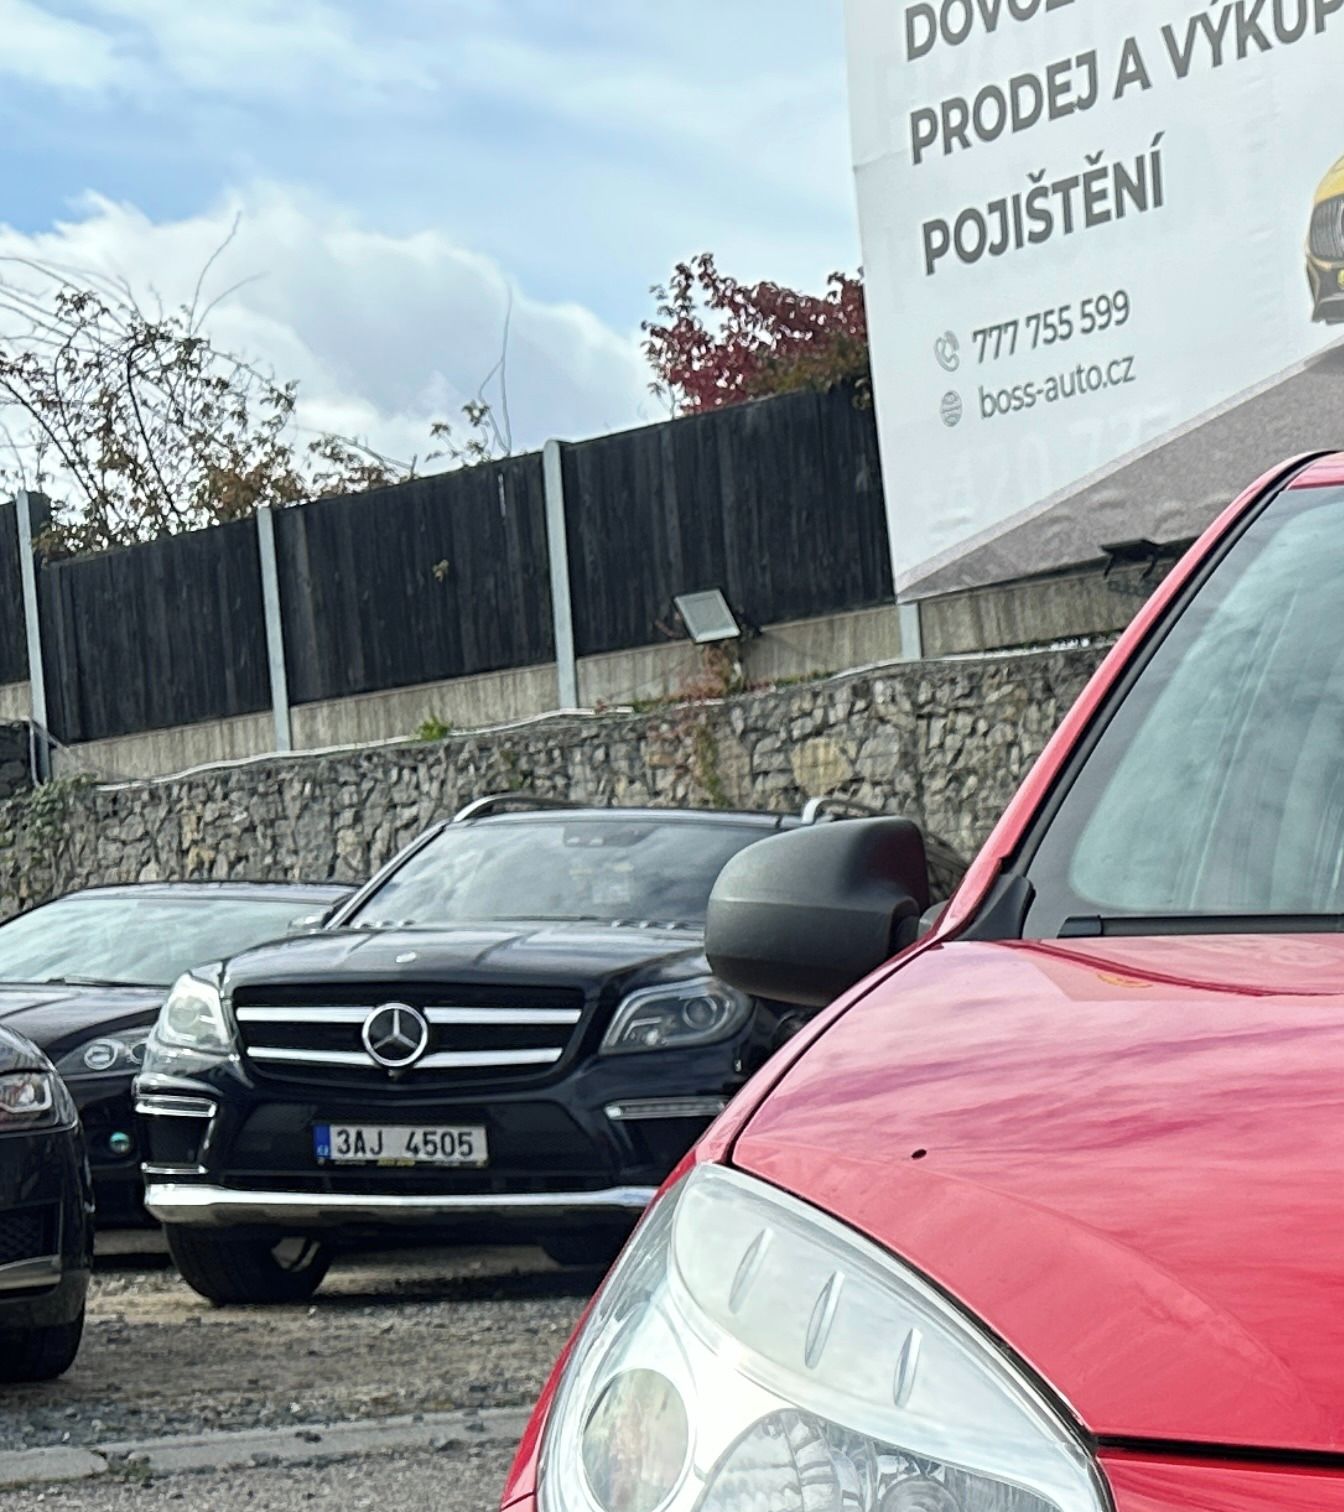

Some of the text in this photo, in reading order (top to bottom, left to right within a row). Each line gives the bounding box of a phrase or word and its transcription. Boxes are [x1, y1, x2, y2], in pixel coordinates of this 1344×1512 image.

[905, 0, 1076, 62] DOV
[911, 49, 1099, 165] PRODEJ
[1113, 36, 1152, 99] A
[922, 130, 1165, 276] POJIŠTĚNÍ
[972, 289, 1130, 364] 777 755 599
[978, 355, 1136, 419] boss-auto.cz
[337, 1129, 383, 1155] 3AJ
[405, 1131, 474, 1157] 4505
